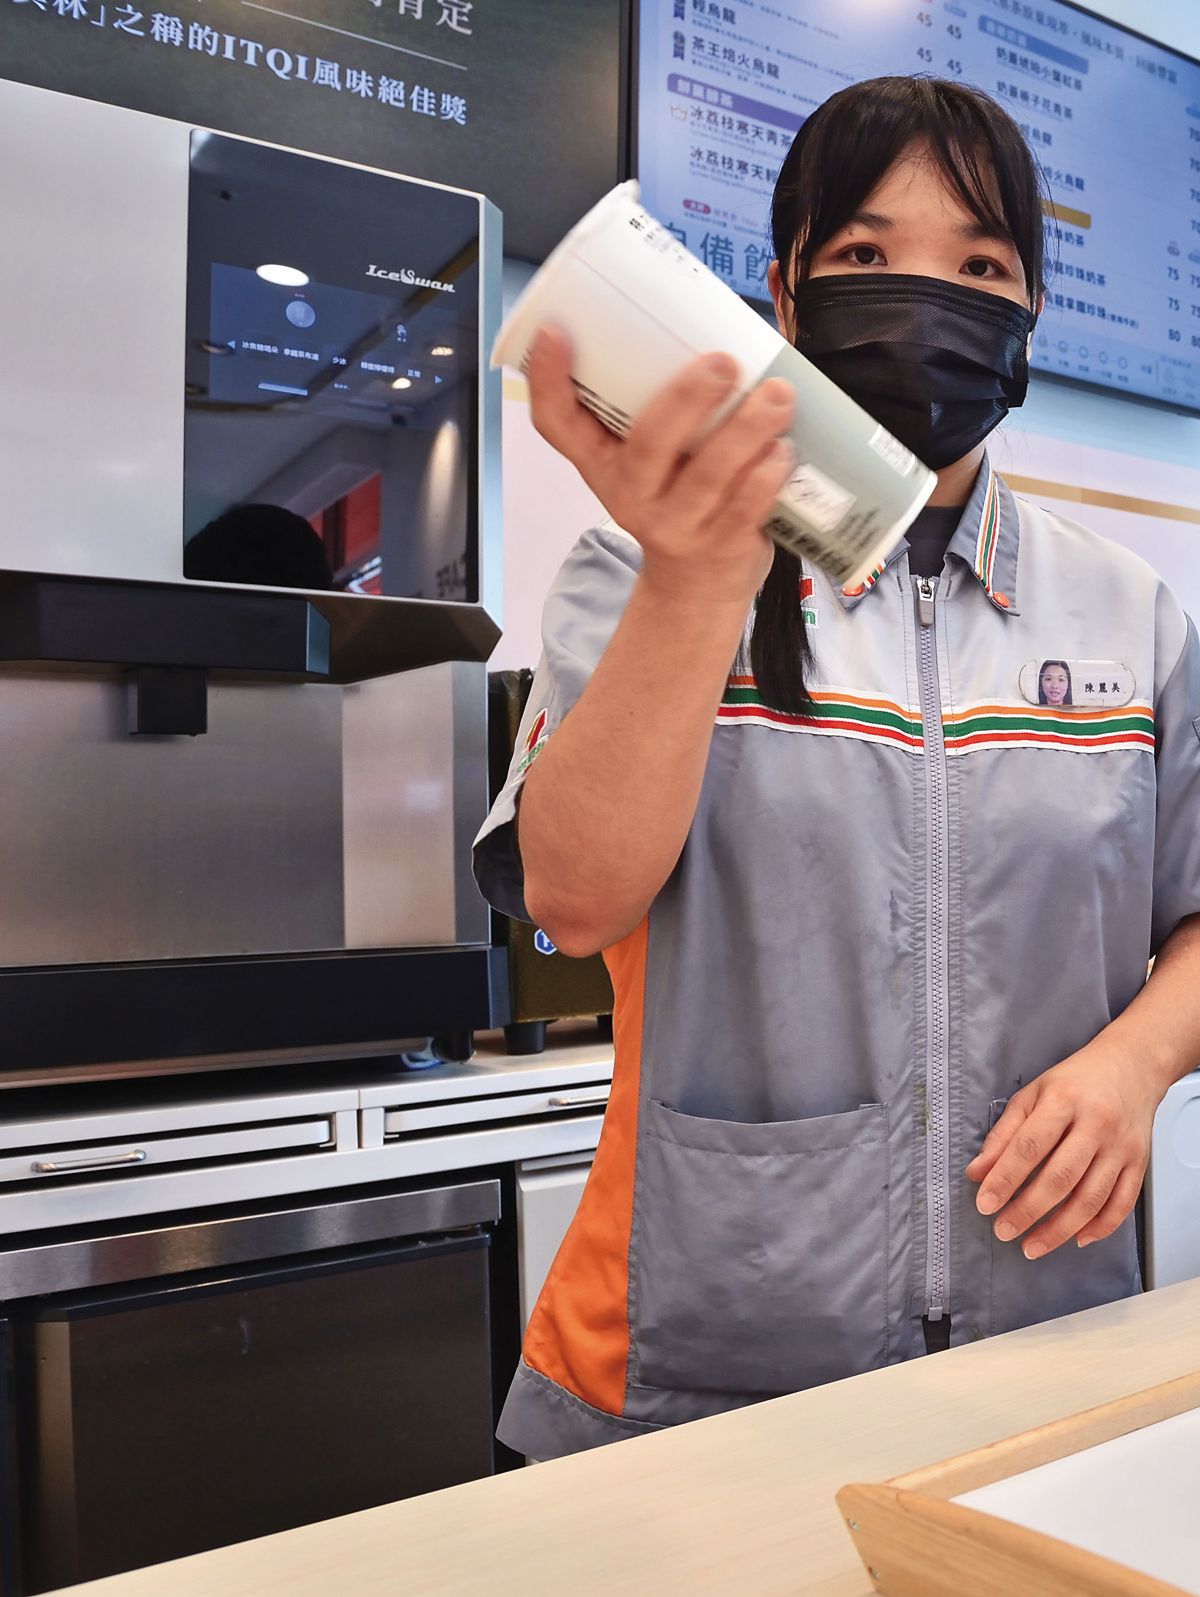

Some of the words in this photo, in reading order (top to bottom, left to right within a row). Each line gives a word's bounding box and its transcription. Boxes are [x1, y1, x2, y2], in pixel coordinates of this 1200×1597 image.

[917, 12, 932, 27] 45
[947, 24, 962, 39] 45
[917, 48, 932, 63] 45
[947, 59, 962, 74] 45
[1167, 267, 1180, 282] 75
[1168, 298, 1180, 312] 75
[1168, 329, 1181, 343] 80
